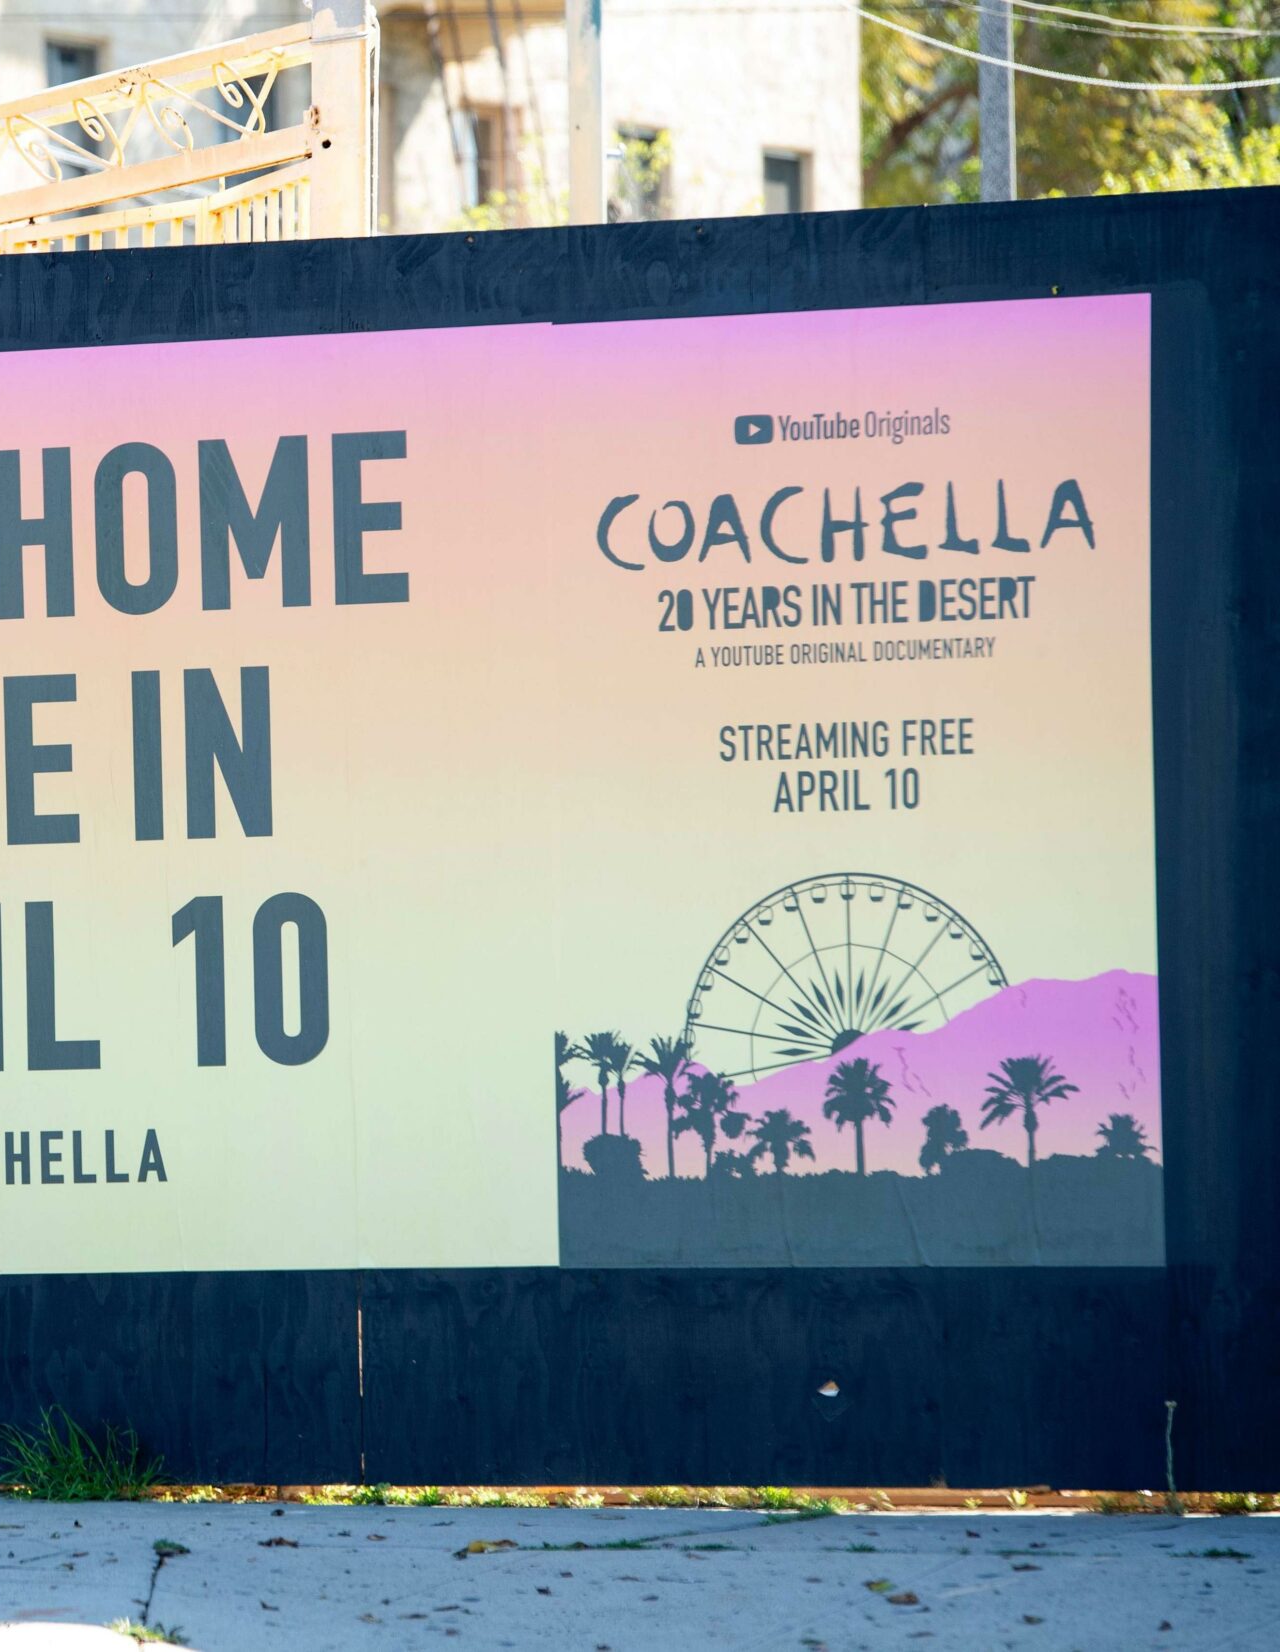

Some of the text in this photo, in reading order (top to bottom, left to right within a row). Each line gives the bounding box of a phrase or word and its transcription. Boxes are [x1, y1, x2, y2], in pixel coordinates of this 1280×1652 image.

[778, 408, 950, 445] YouTube Originals
[596, 479, 1096, 571] COACHELLA
[658, 576, 1036, 632] 20 YEARS IN THE DESERT
[695, 637, 995, 668] A YOUTUBE ORIGINAL DOCUMENTARY
[131, 666, 273, 841] IN
[719, 718, 974, 762] STREAMING FREE
[773, 767, 919, 813] APRIL 10
[172, 892, 330, 1067] 10
